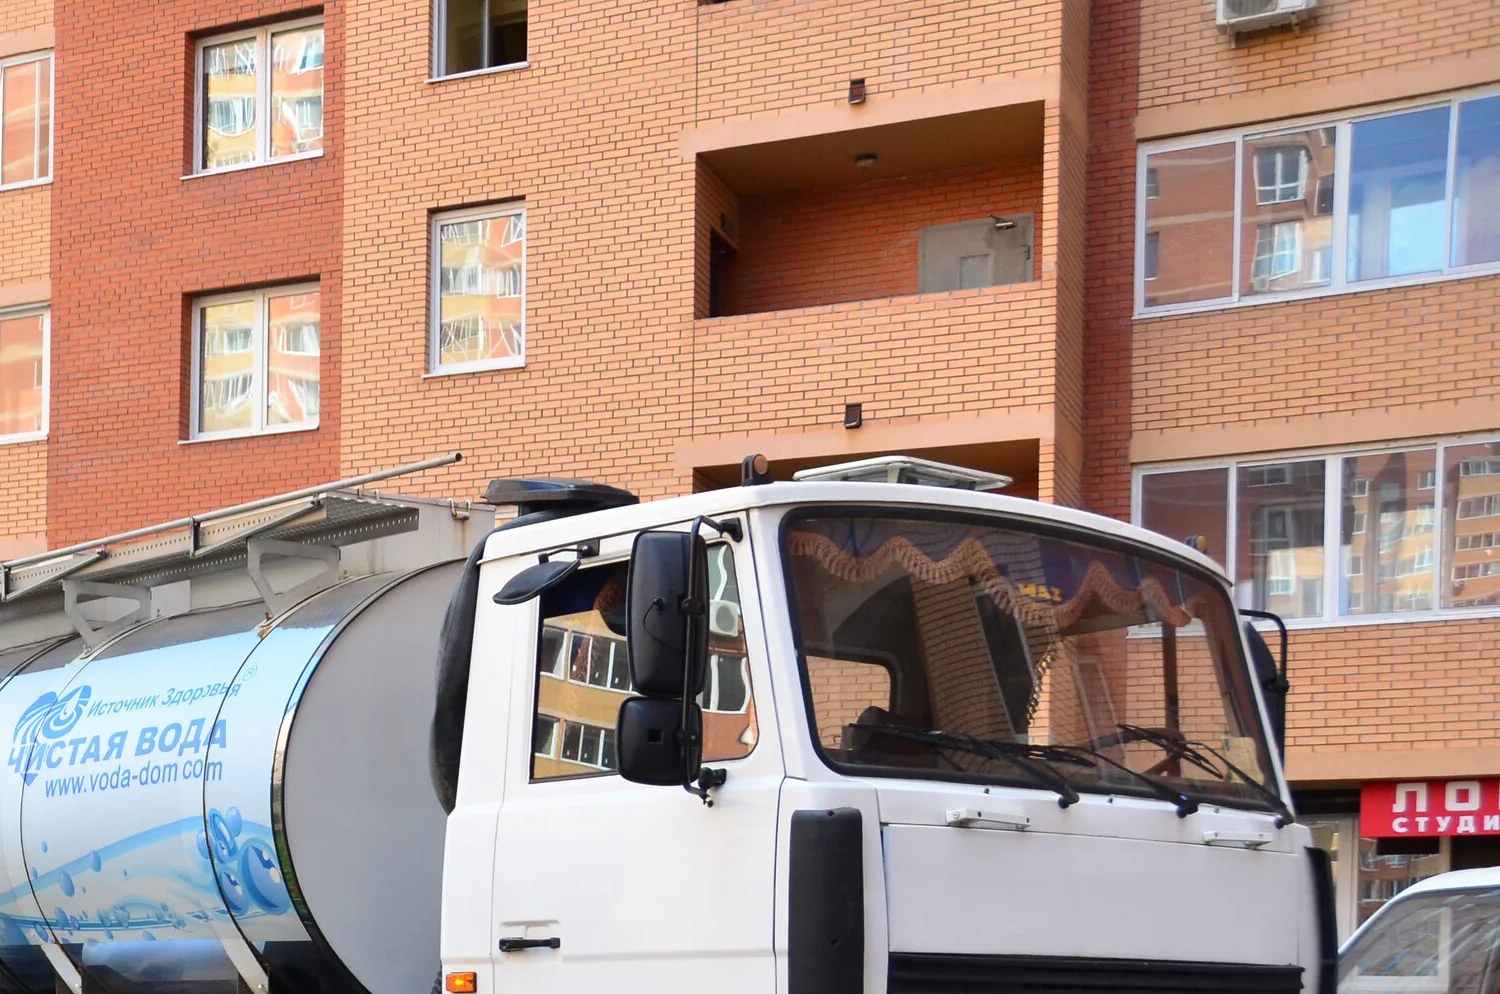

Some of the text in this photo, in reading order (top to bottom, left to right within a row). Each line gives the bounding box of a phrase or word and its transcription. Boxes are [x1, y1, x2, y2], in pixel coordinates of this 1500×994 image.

[87, 693, 161, 718] Источник
[161, 681, 242, 707] Здоровья
[7, 718, 227, 774] ЧИСТАЯ ВОДА
[1392, 781, 1500, 813] ЛО
